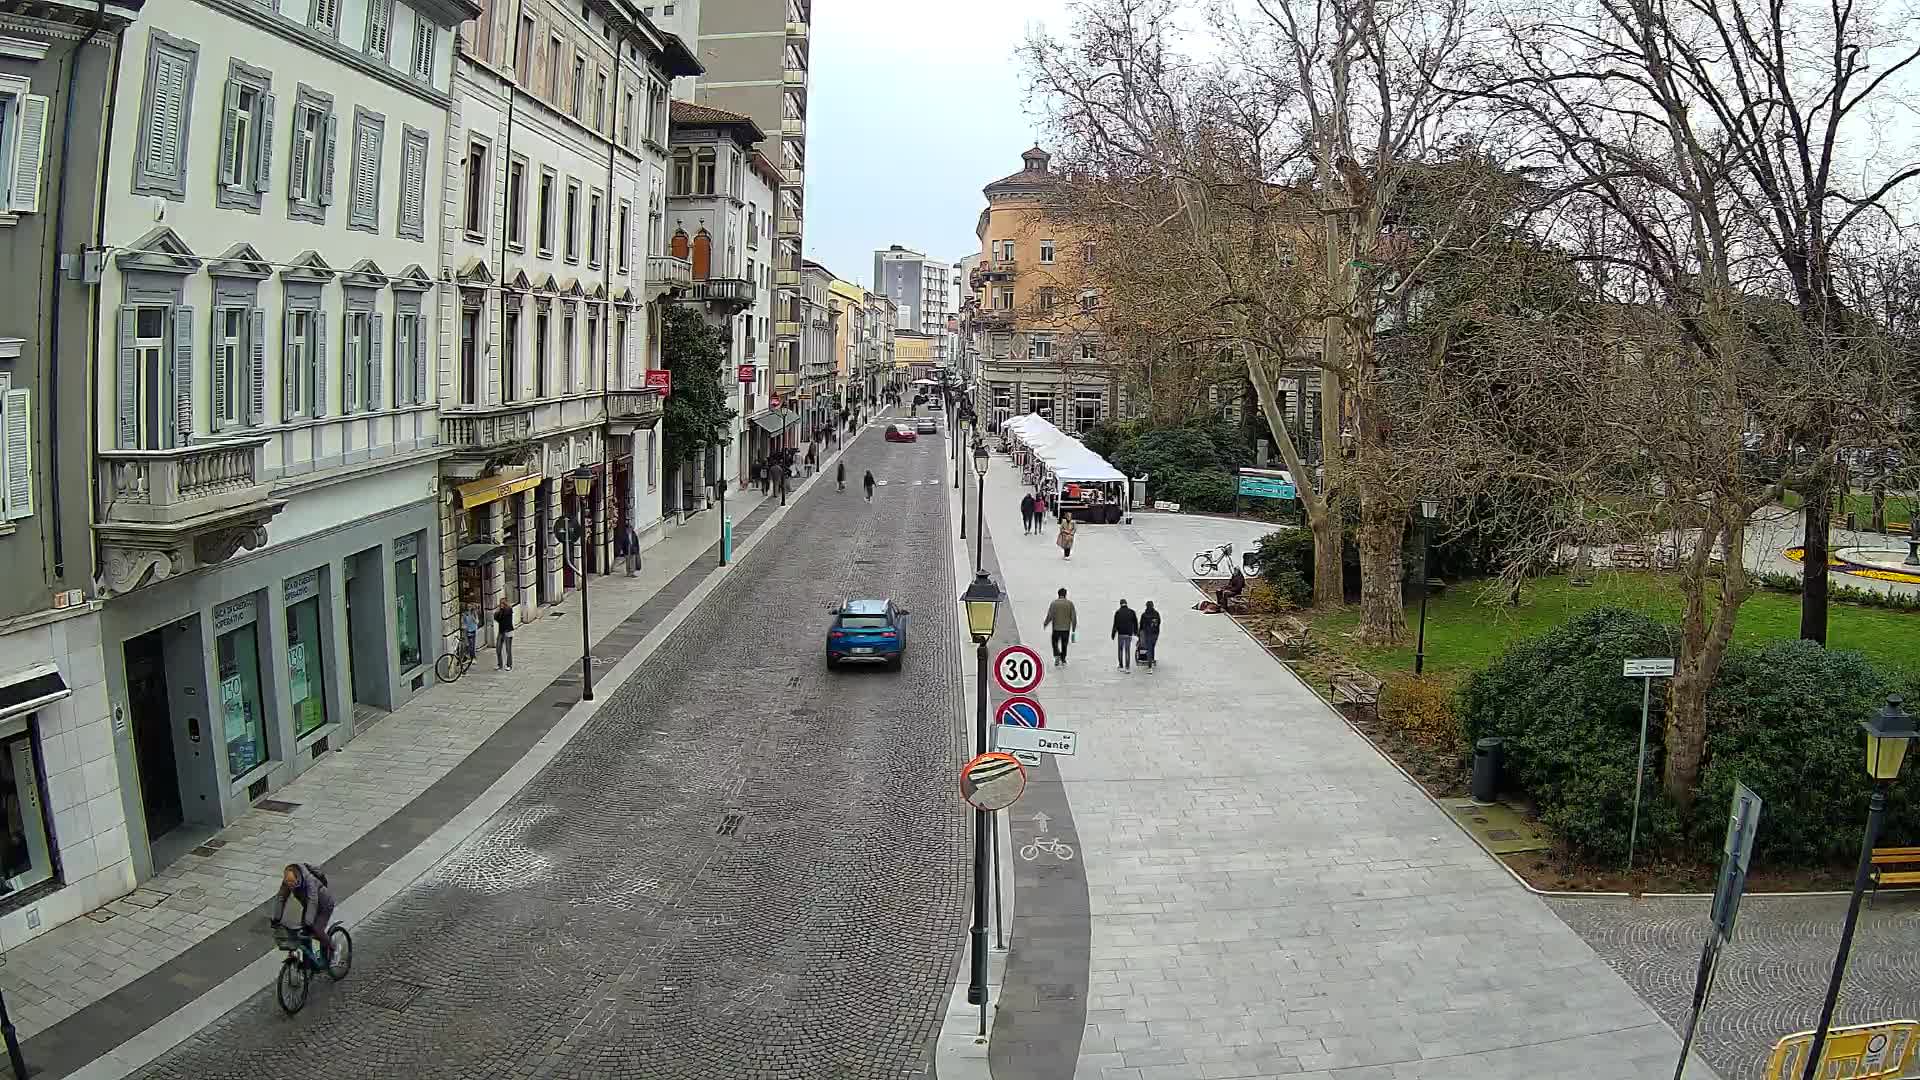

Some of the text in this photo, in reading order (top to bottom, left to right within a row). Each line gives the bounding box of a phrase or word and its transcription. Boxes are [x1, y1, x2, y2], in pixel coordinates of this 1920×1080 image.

[288, 645, 304, 666] 130
[1005, 659, 1033, 681] 30
[223, 678, 241, 702] 130
[1038, 738, 1070, 750] Dante
